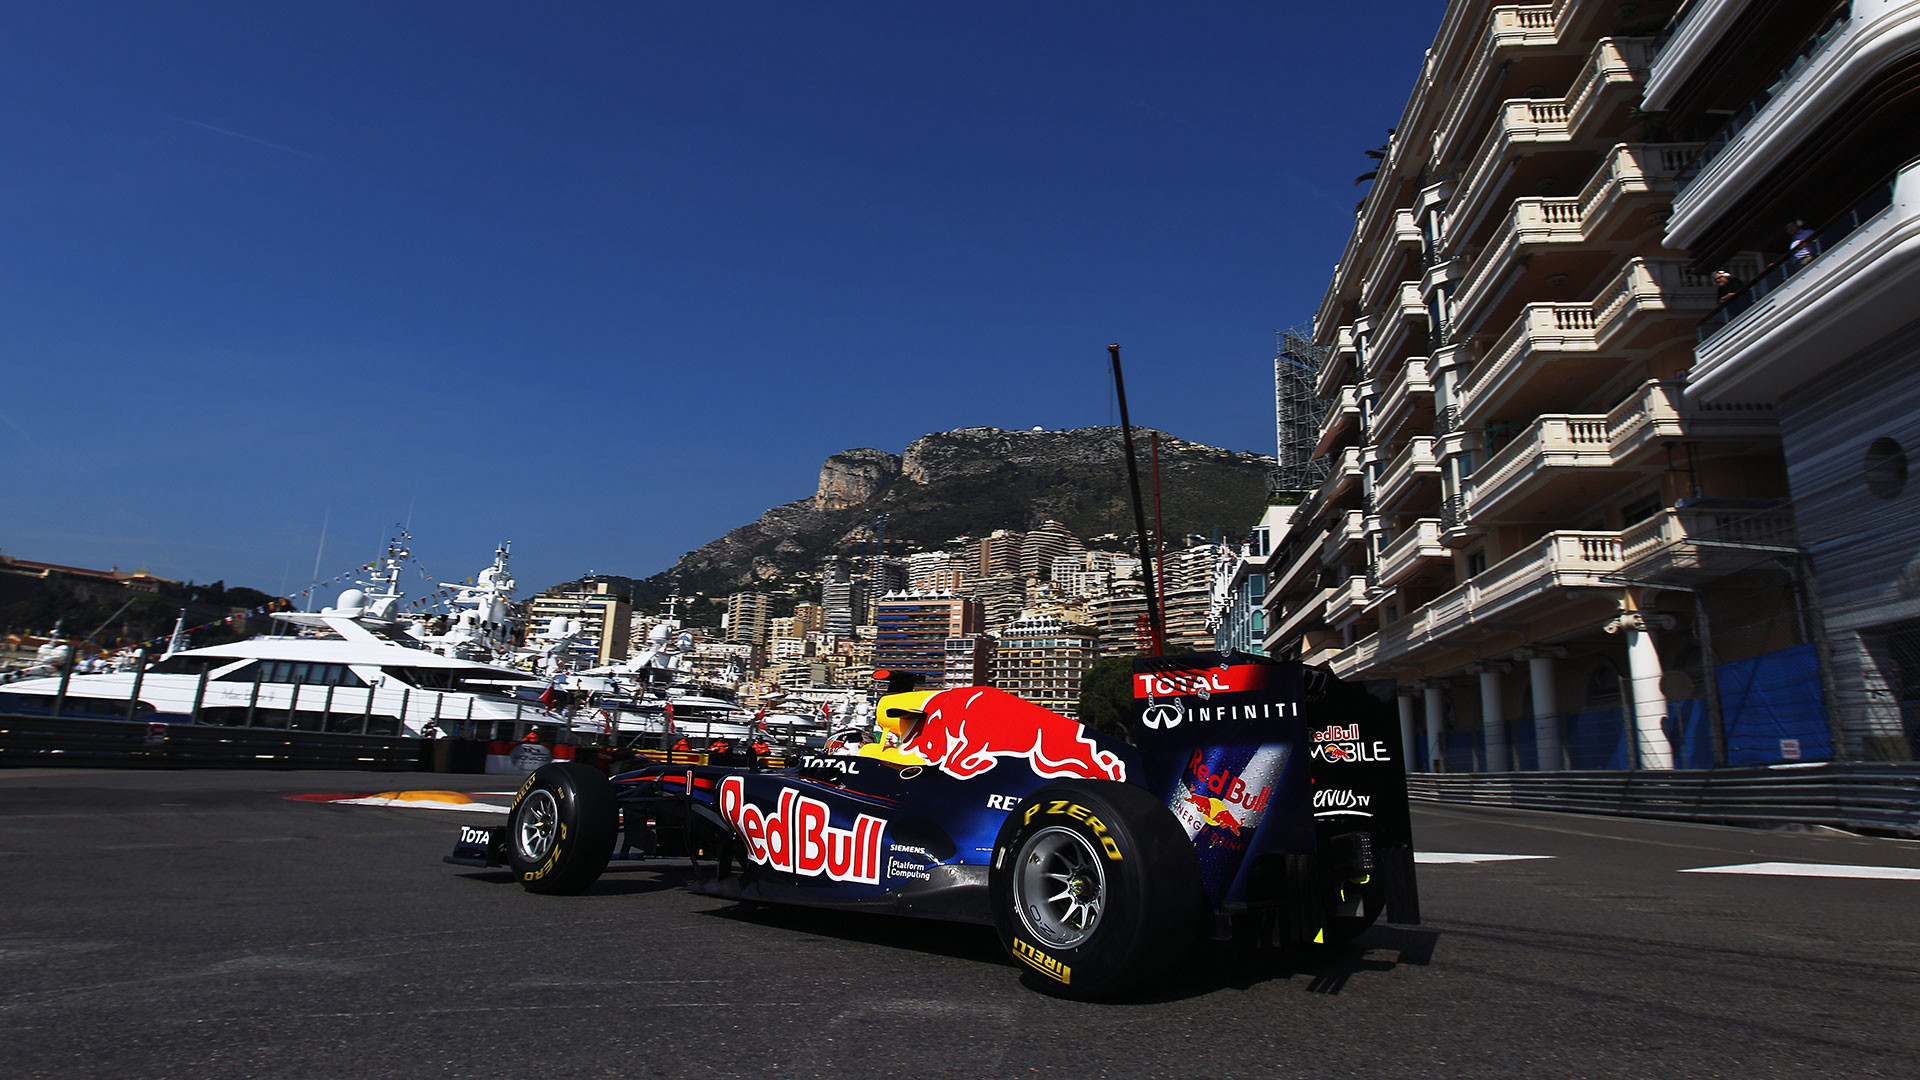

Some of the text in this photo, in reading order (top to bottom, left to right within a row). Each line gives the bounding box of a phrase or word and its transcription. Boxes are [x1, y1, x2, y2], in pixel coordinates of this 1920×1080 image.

[1139, 673, 1230, 695] TOTAL
[1188, 702, 1298, 722] INFINITI
[1333, 723, 1360, 741] Bull
[802, 755, 860, 775] TOTAL
[1189, 747, 1272, 812] Red Bull
[986, 793, 1023, 812] RE
[461, 825, 490, 845] TOTA
[720, 776, 888, 886] Red Bull
[1024, 800, 1124, 861] P ZERO
[1174, 800, 1244, 852] ENERGY DRINK
[524, 822, 568, 881] P ZERO
[889, 844, 926, 854] SIEMENS
[891, 868, 931, 881] Computing
[892, 860, 925, 871] Platform
[1012, 937, 1072, 985] PIRELLI
